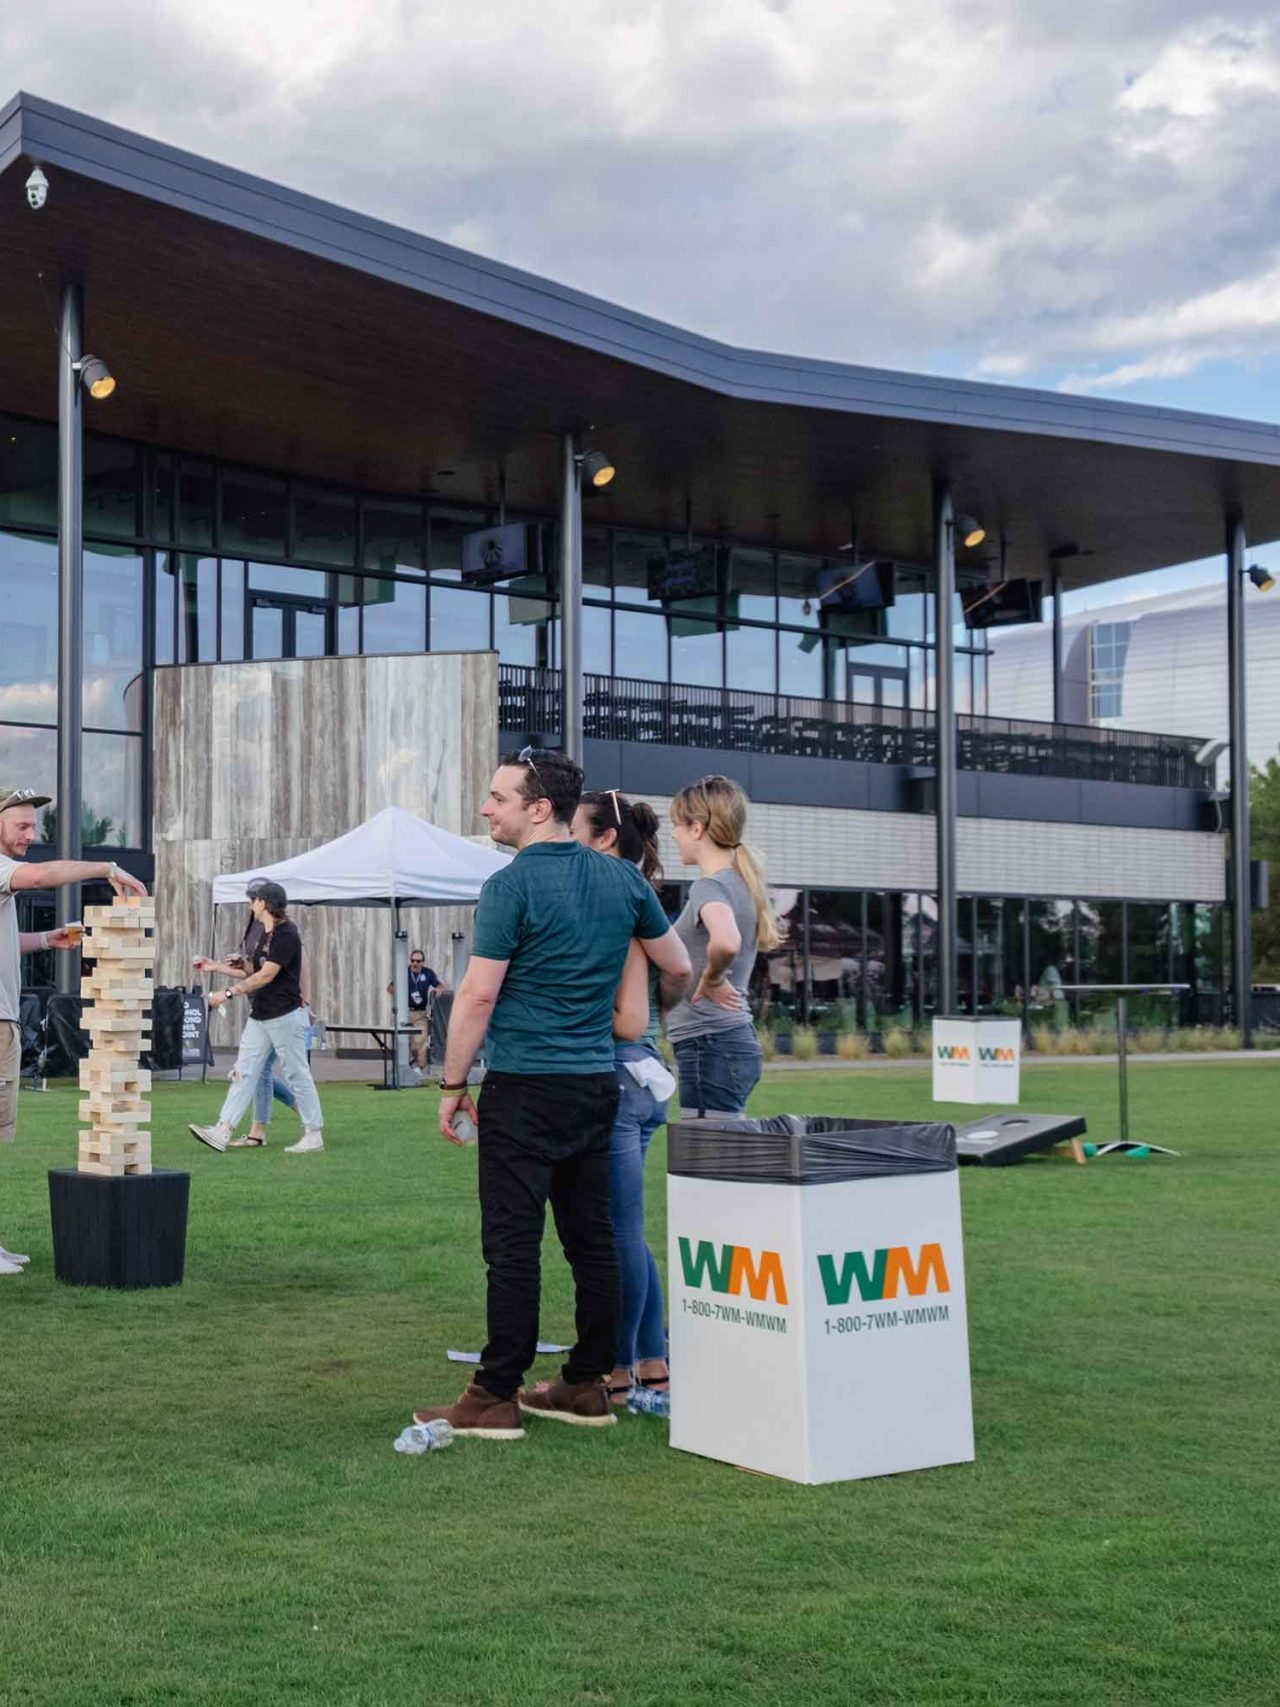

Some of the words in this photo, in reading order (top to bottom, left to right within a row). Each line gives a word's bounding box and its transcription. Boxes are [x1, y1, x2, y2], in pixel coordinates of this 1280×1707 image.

[937, 1046, 970, 1060] WM
[978, 1047, 1015, 1061] WM
[678, 1236, 789, 1306] WM
[816, 1243, 951, 1306] WM
[681, 1298, 788, 1334] 1-800-7WM-WMWM
[824, 1305, 950, 1335] 1-800-7WM-WMWM
